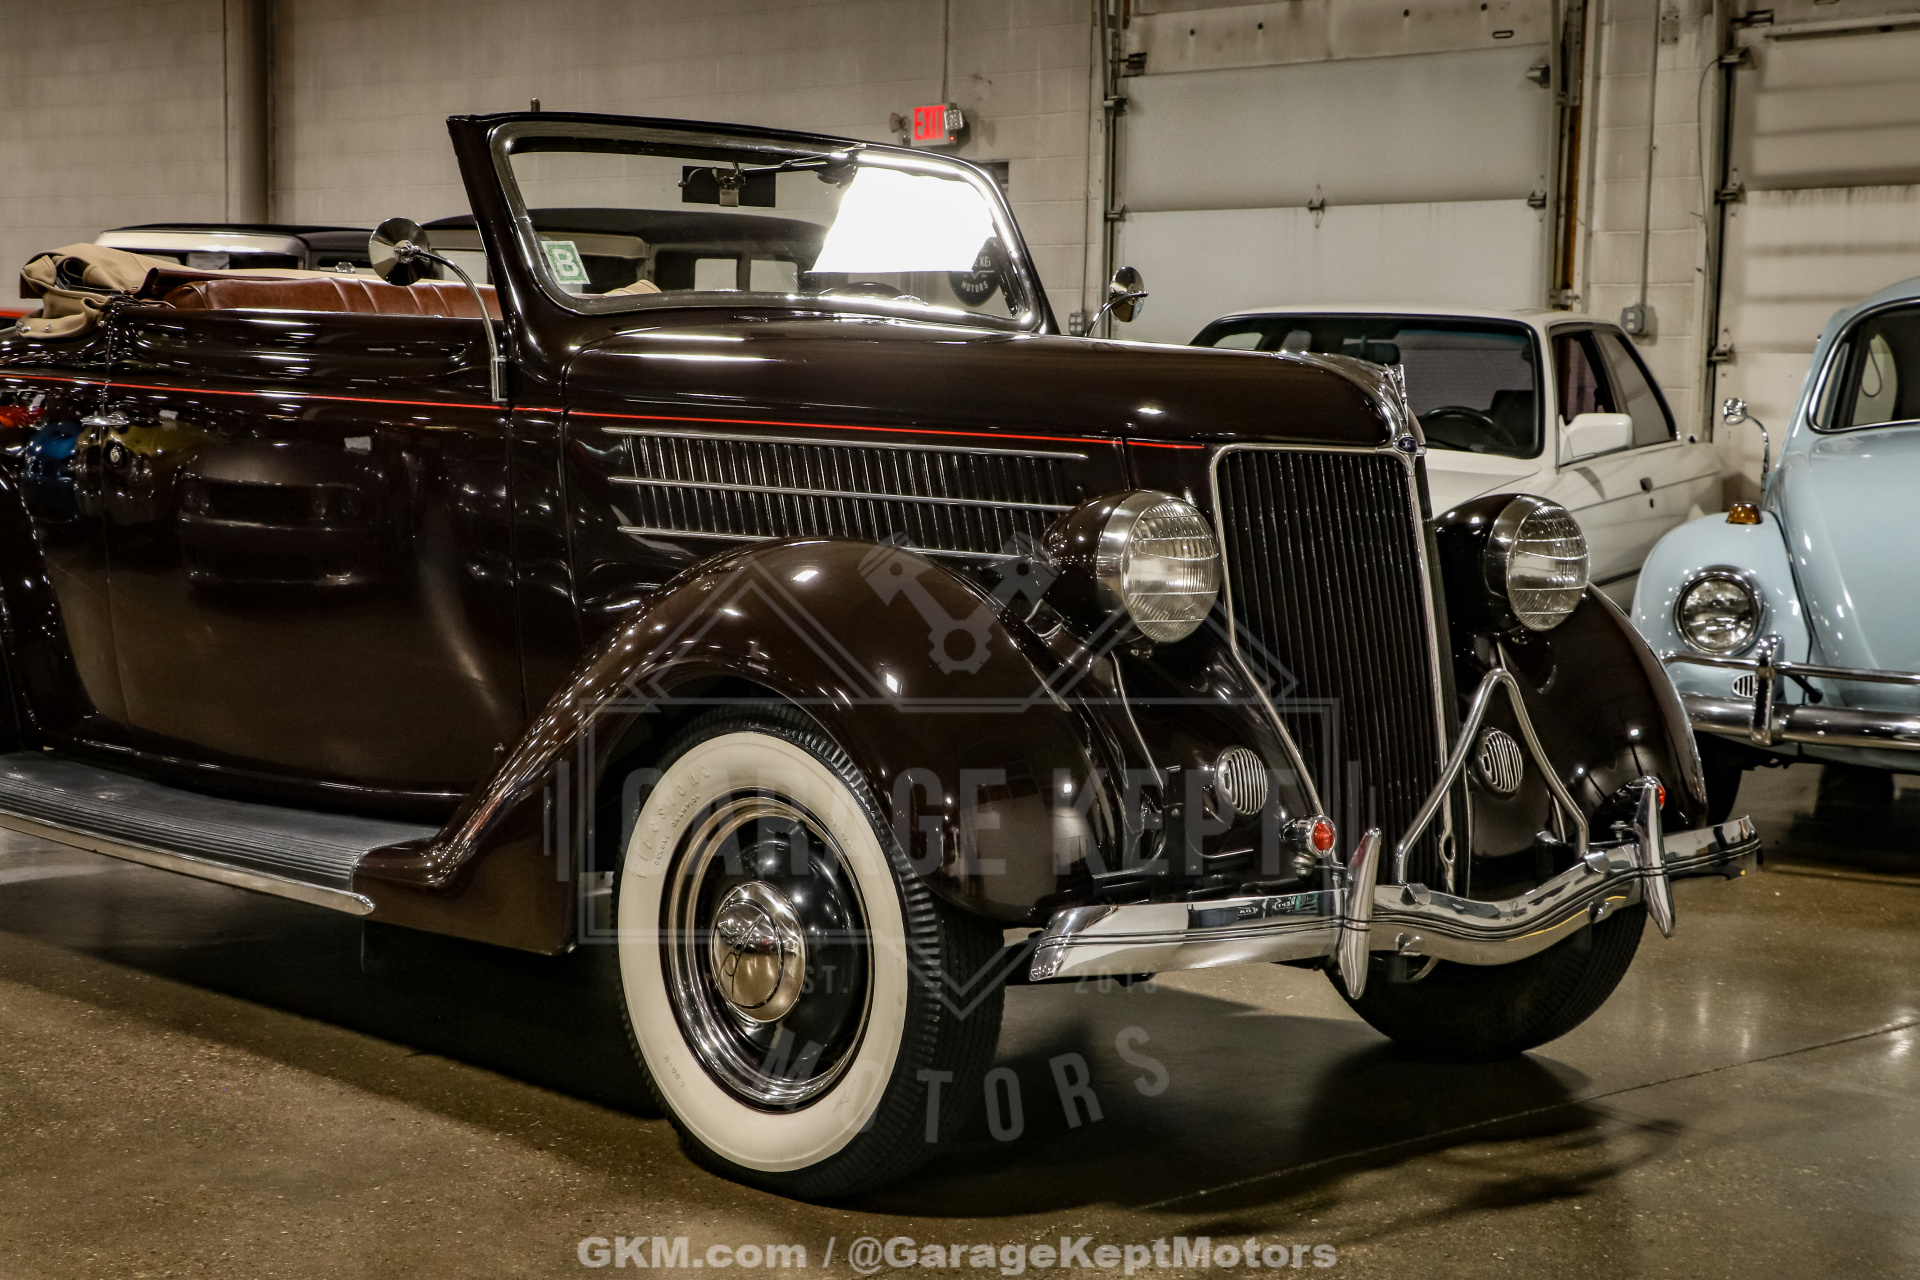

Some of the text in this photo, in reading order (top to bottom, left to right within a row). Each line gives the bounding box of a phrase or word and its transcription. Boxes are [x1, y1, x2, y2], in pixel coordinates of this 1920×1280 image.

[914, 105, 946, 141] EXIT
[551, 248, 580, 277] B
[961, 280, 989, 293] MOTORS
